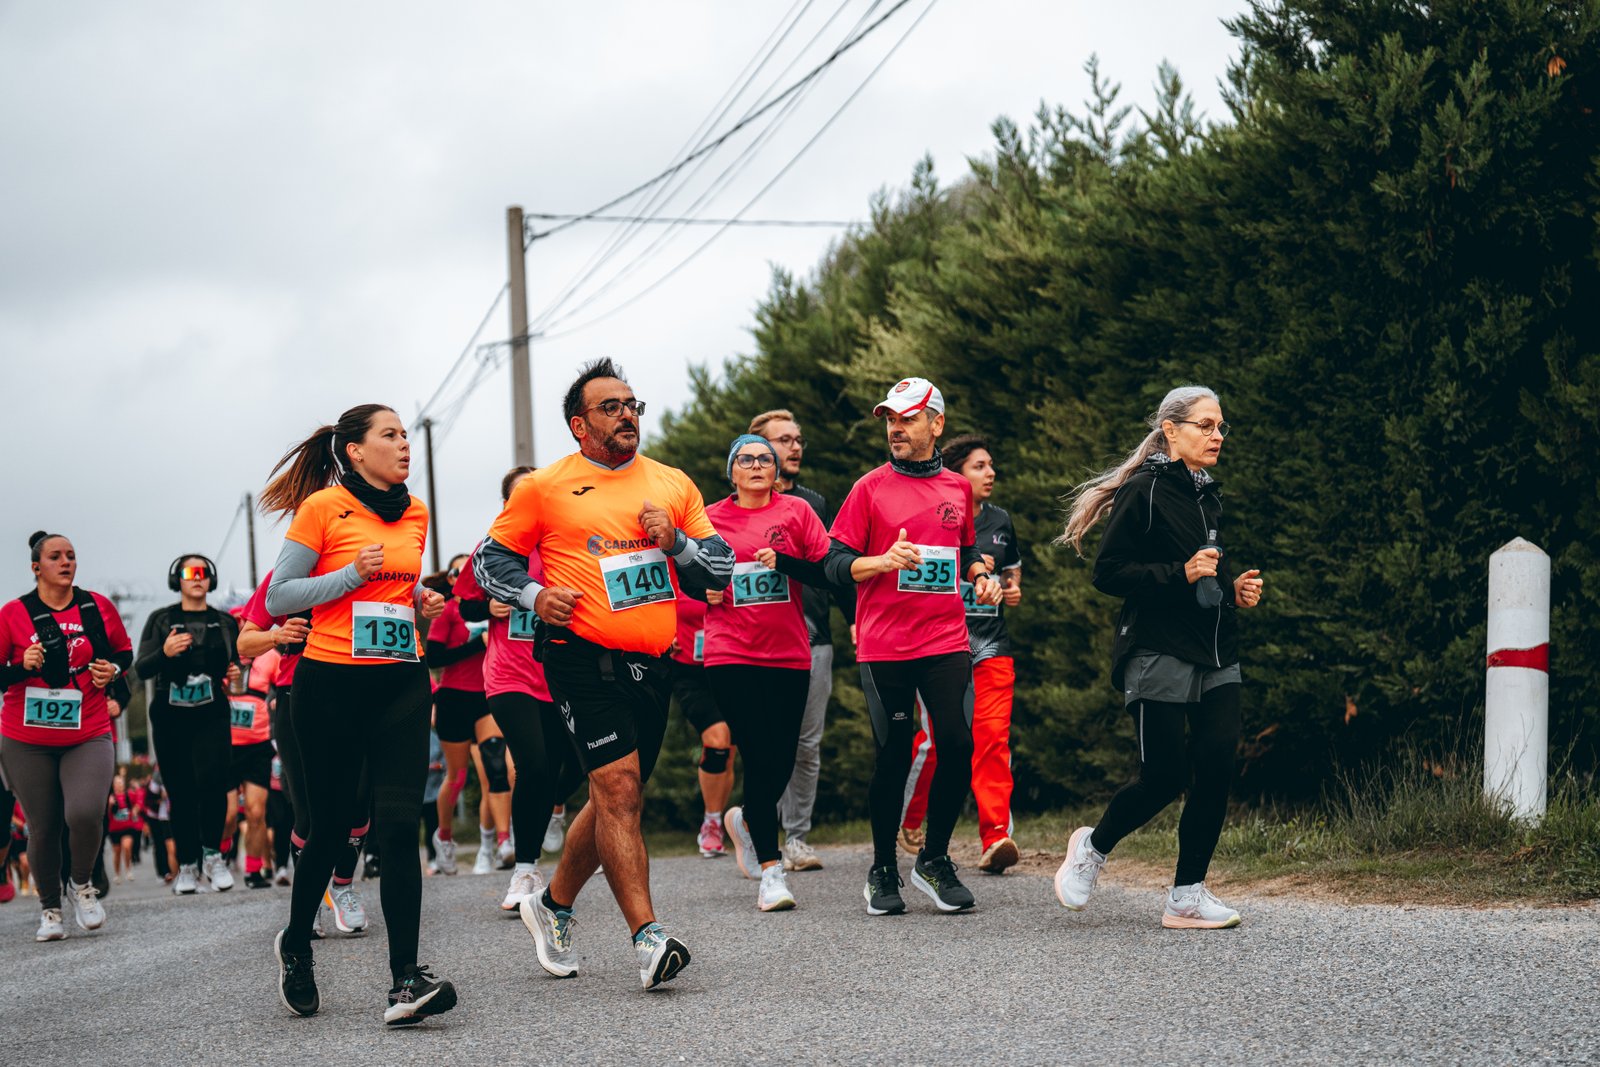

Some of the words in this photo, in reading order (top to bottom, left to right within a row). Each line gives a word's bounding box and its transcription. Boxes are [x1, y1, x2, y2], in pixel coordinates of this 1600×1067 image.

[604, 537, 657, 550] CARAYON
[368, 571, 416, 583] CARAYON
[616, 565, 666, 596] 140
[907, 560, 950, 584] 535
[741, 573, 784, 596] 162
[518, 612, 540, 632] 16
[364, 619, 411, 649] 139
[33, 700, 74, 720] 192
[586, 731, 618, 750] hummel
